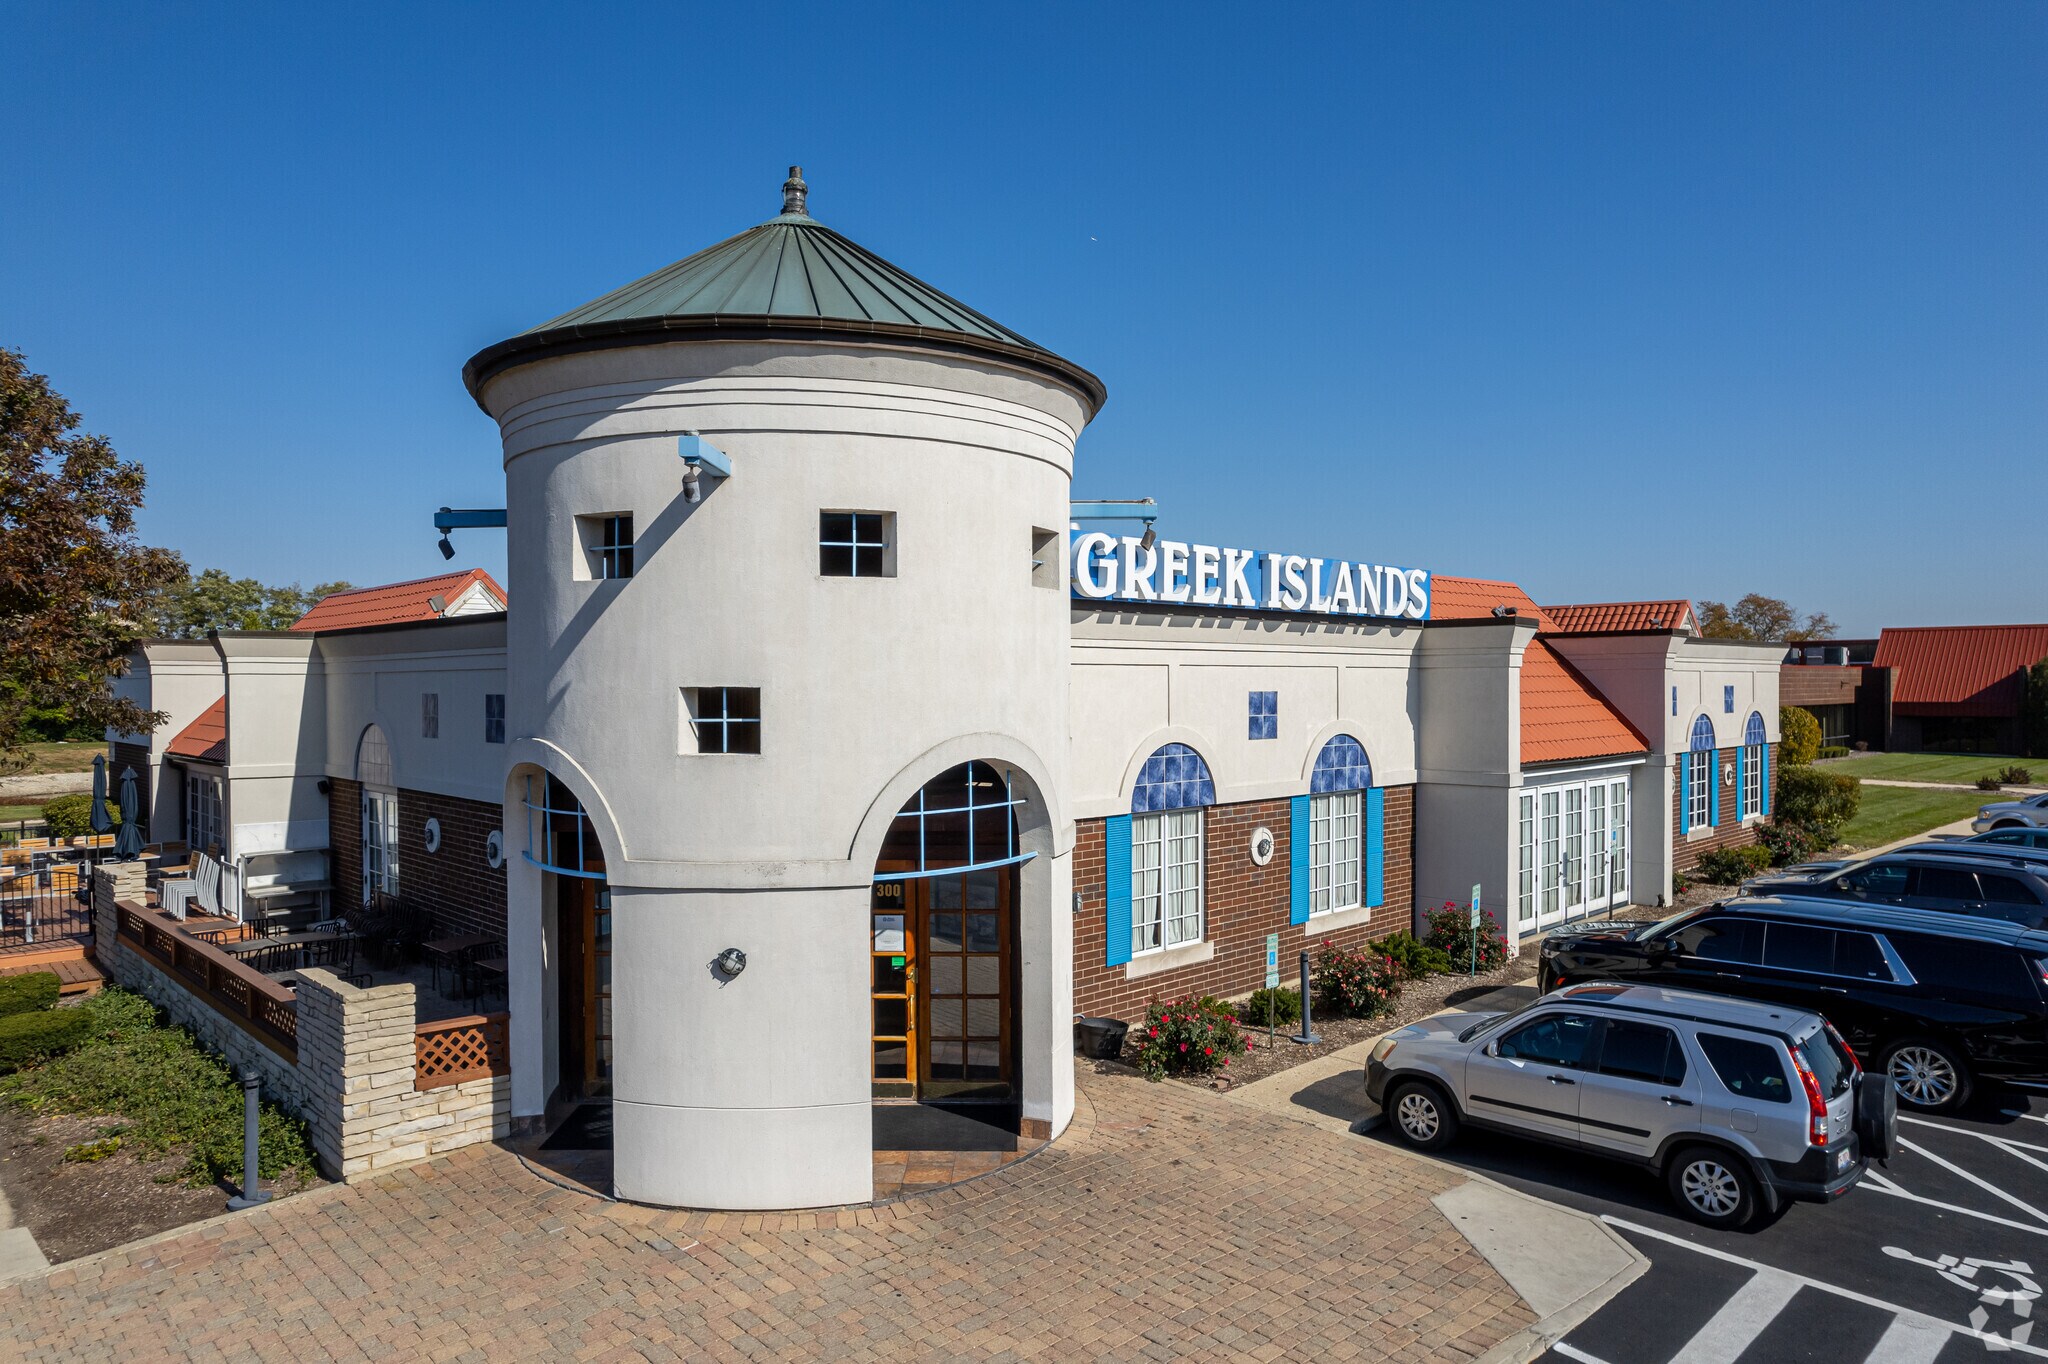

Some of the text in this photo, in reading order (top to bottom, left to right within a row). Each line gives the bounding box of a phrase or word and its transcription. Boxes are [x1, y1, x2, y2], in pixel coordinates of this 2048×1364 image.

[1075, 532, 1428, 619] GREEK ISLANDS
[877, 884, 901, 897] 300
